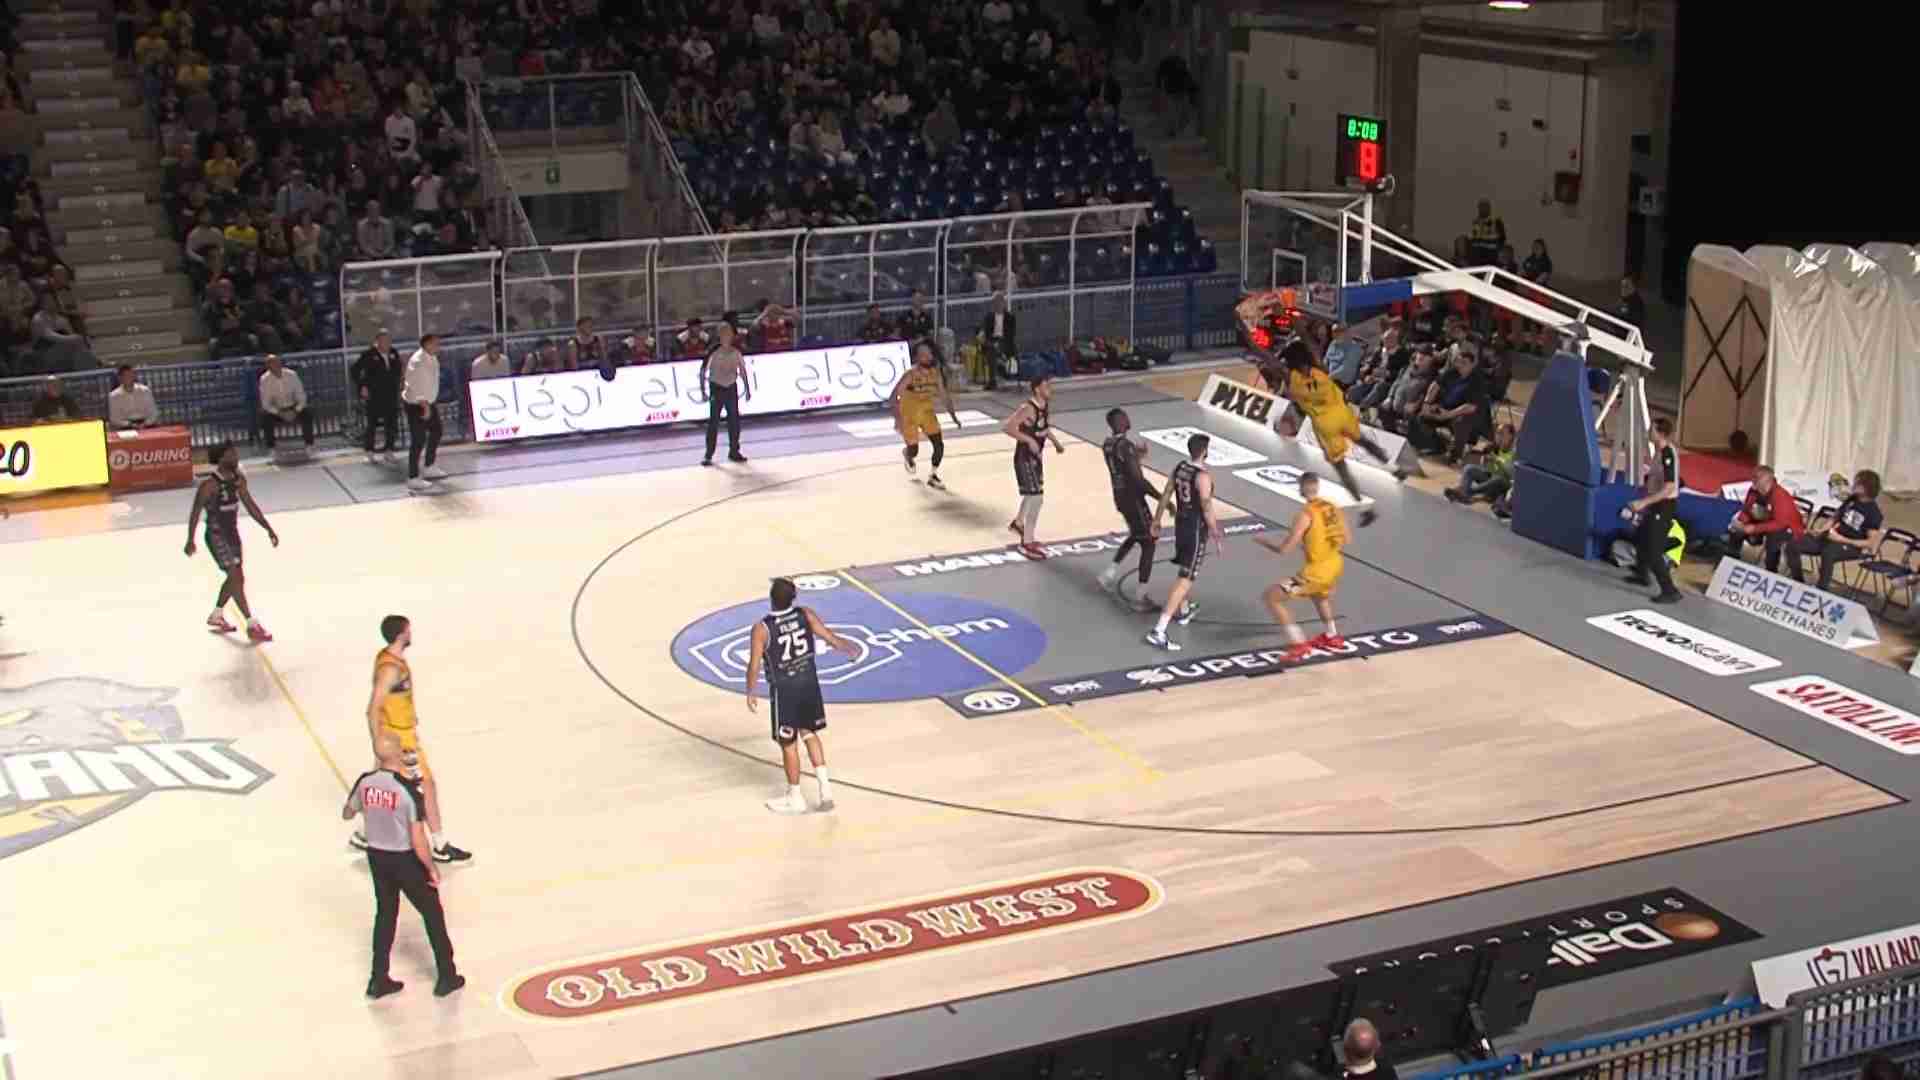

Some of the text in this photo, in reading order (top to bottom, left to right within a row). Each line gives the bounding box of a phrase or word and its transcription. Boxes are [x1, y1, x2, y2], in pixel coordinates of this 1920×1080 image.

[131, 447, 190, 465] DURING
[1720, 588, 1837, 640] POLYURETHANES
[1727, 565, 1831, 620] EPAFLEX
[777, 629, 808, 661] 75
[545, 876, 1113, 1009] OLD WILD WEST
